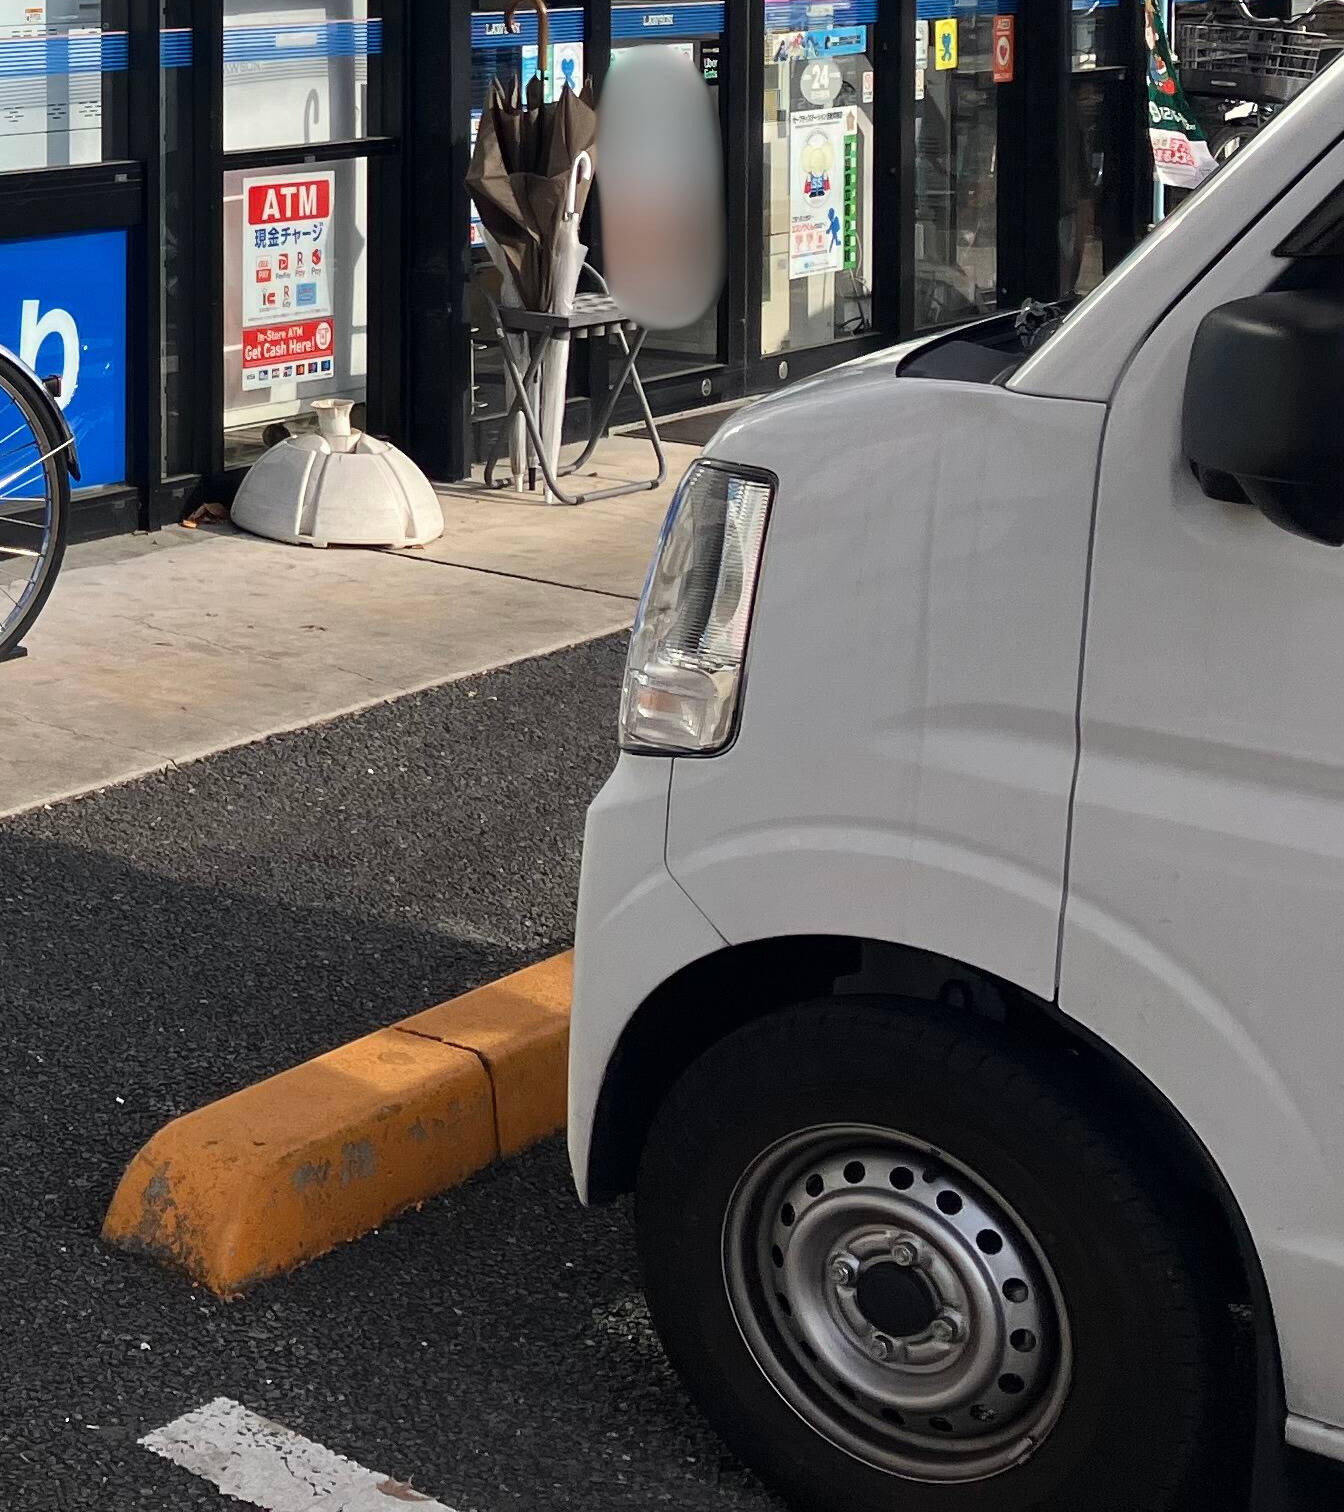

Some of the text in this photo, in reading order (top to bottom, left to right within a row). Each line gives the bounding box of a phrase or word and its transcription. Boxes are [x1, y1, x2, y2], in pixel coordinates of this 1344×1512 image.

[814, 62, 830, 88] 24
[261, 184, 318, 221] ATM
[254, 223, 324, 249] 現金チャージ
[256, 326, 303, 343] In-Store ATM
[244, 337, 315, 361] Get Cash Here!
